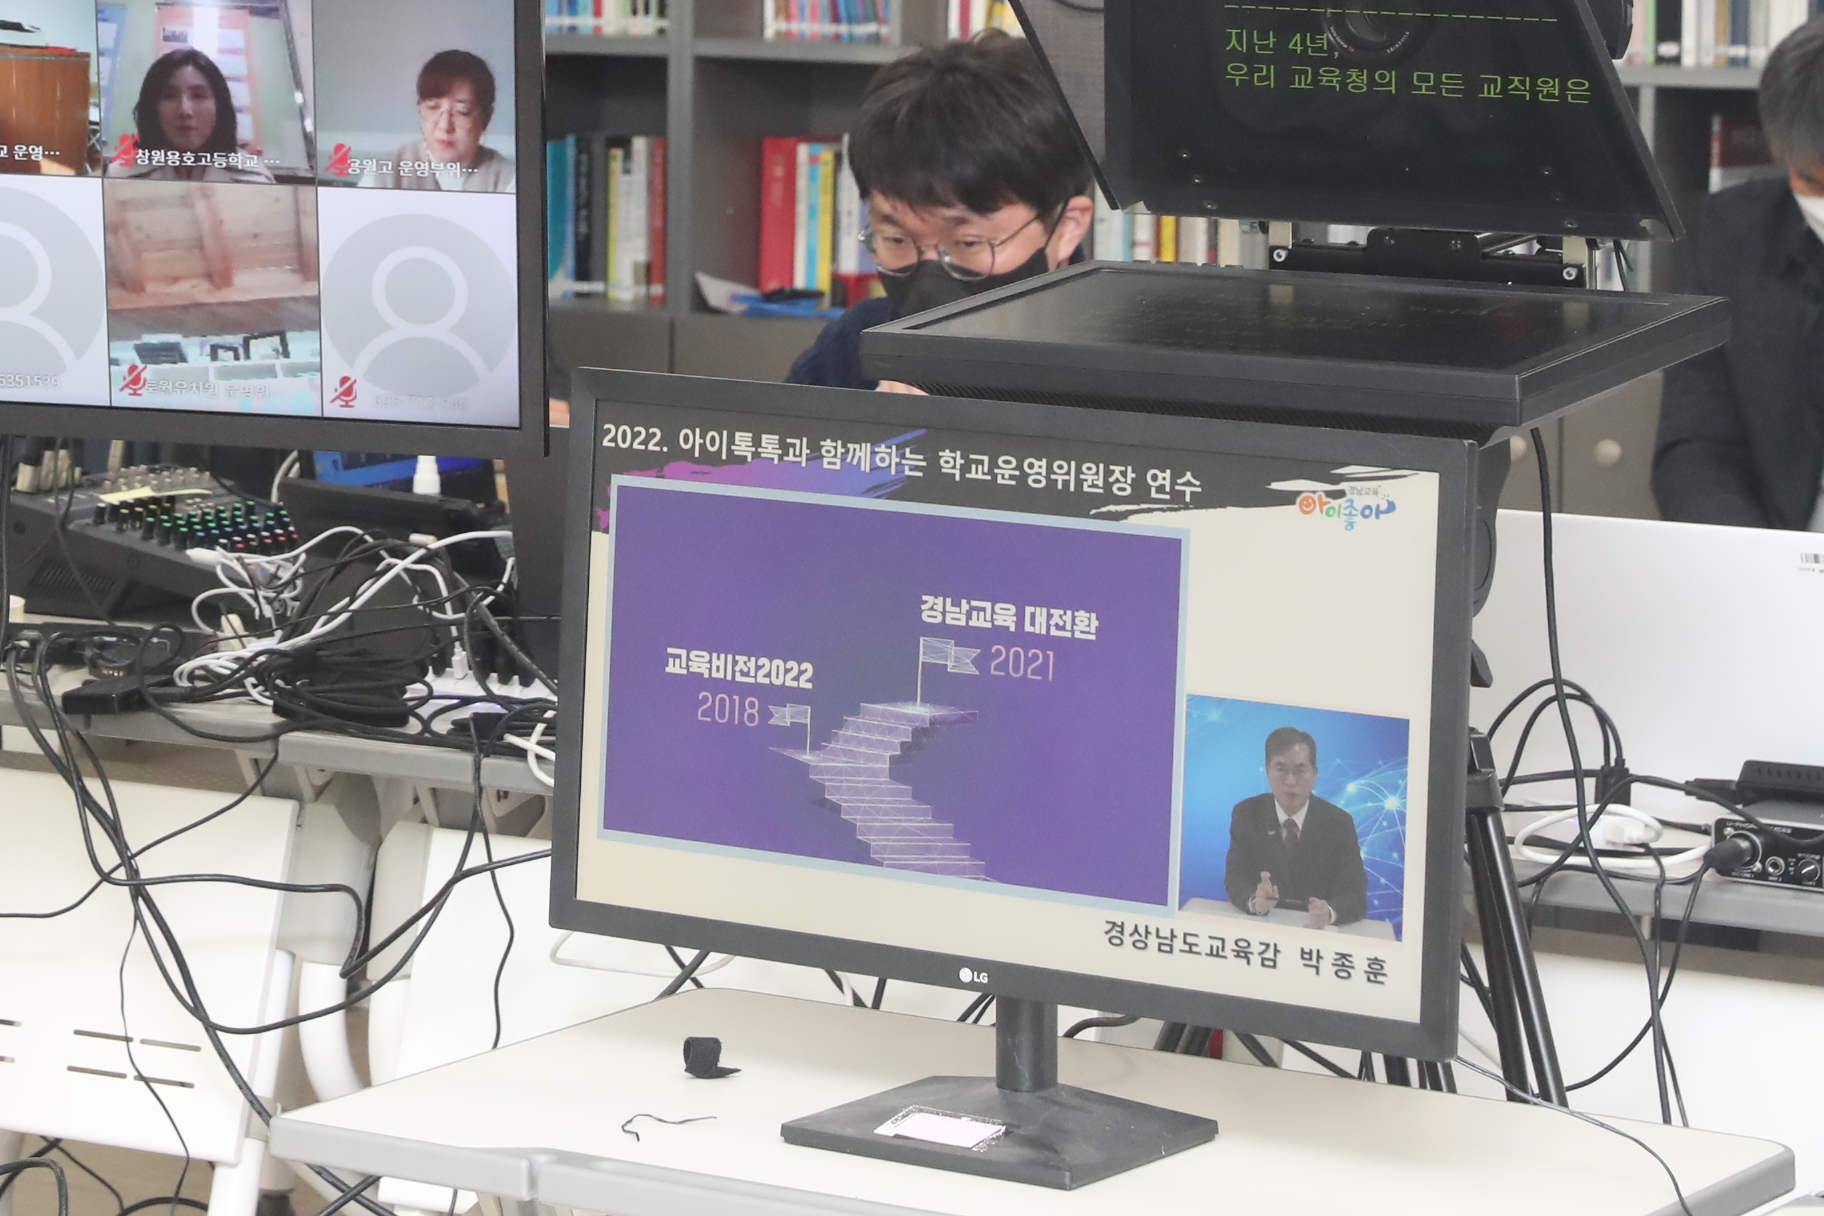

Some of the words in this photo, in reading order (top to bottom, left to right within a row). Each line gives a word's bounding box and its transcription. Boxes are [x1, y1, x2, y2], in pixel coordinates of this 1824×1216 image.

[1224, 28, 1278, 55] 지난
[1288, 30, 1342, 59] 4년,
[1224, 63, 1276, 90] 우리
[1288, 66, 1398, 96] 교육청의
[1411, 71, 1466, 99] 모든
[1476, 74, 1592, 105] 교직원은
[134, 148, 259, 169] 창원용호고등학교
[600, 421, 670, 455] 2022.
[676, 424, 811, 469] 아이톡톡과
[819, 435, 929, 481] 함께하는
[937, 447, 1135, 501] 학교운영위원장
[1143, 462, 1204, 506] 연수
[919, 595, 1018, 634] 경남교육
[1024, 606, 1100, 641] 대전환
[664, 646, 814, 690] 교육비전2022
[989, 645, 1055, 683] 2021
[696, 690, 761, 728] 2018
[1102, 917, 1284, 971] 경상남도교육감
